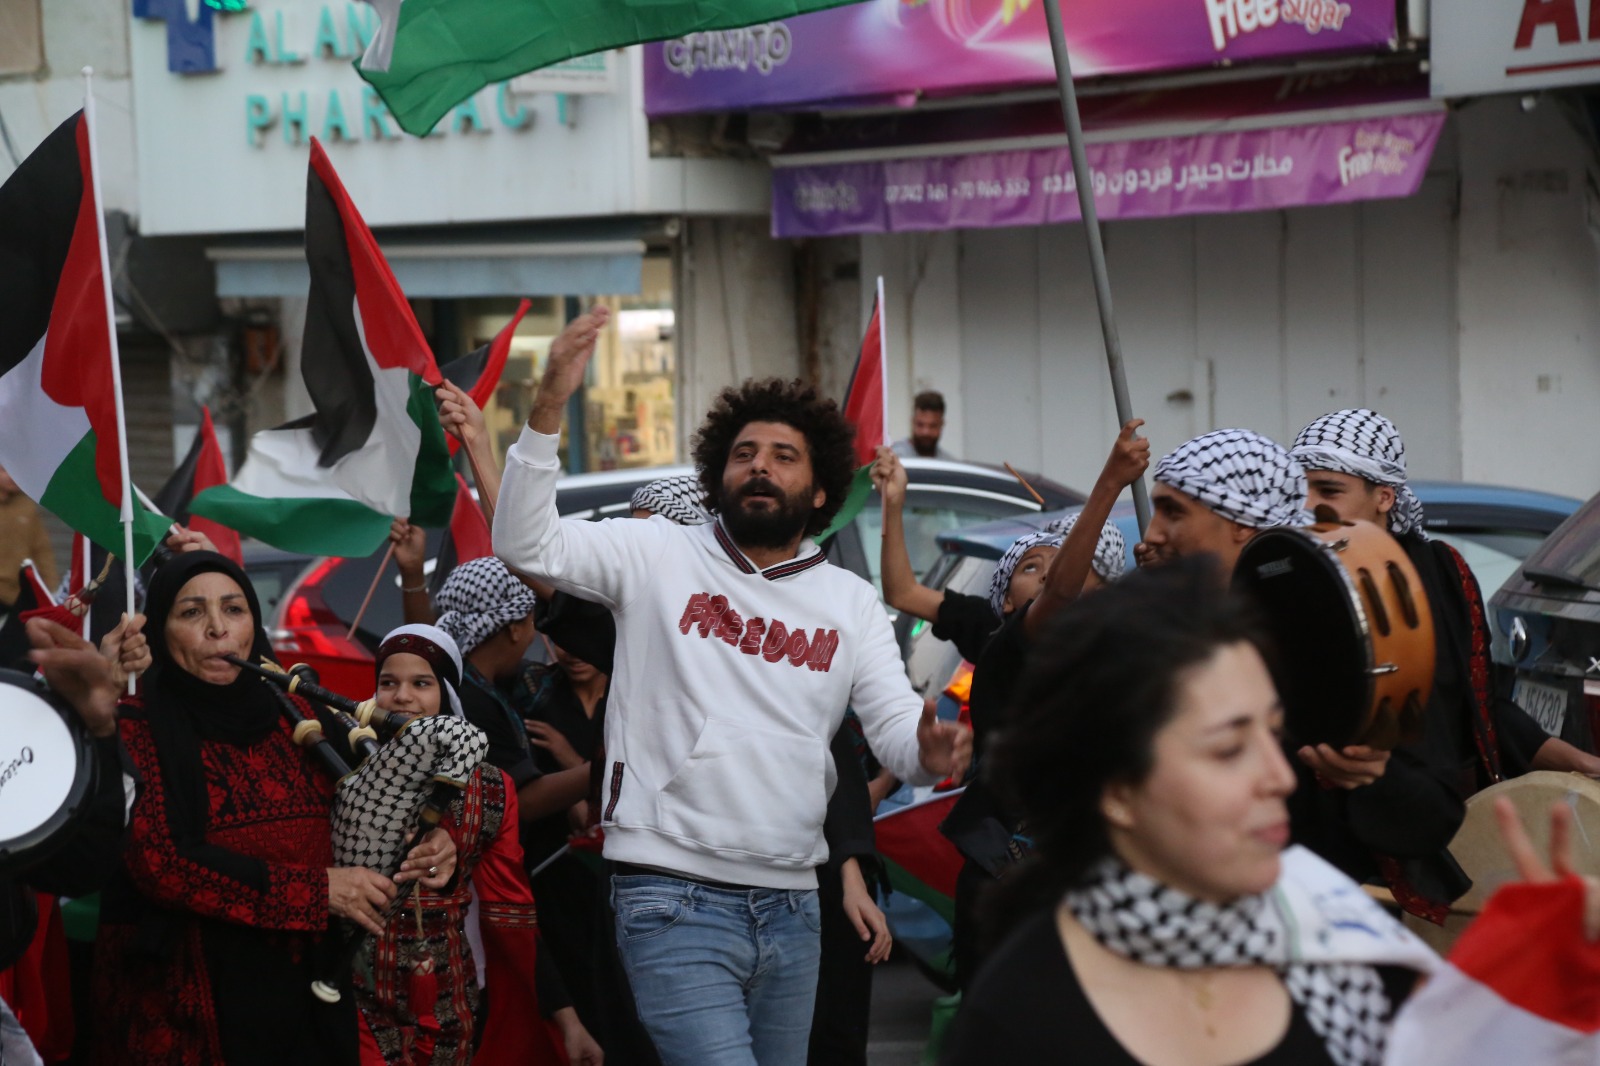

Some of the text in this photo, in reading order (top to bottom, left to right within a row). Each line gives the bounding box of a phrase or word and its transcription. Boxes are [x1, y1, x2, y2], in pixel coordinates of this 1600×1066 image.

[1205, 0, 1280, 51] Free
[1514, 0, 1600, 49] A
[1174, 161, 1224, 191] حيدر
[1226, 153, 1294, 181] محلات
[678, 591, 839, 673] FREEDOM
